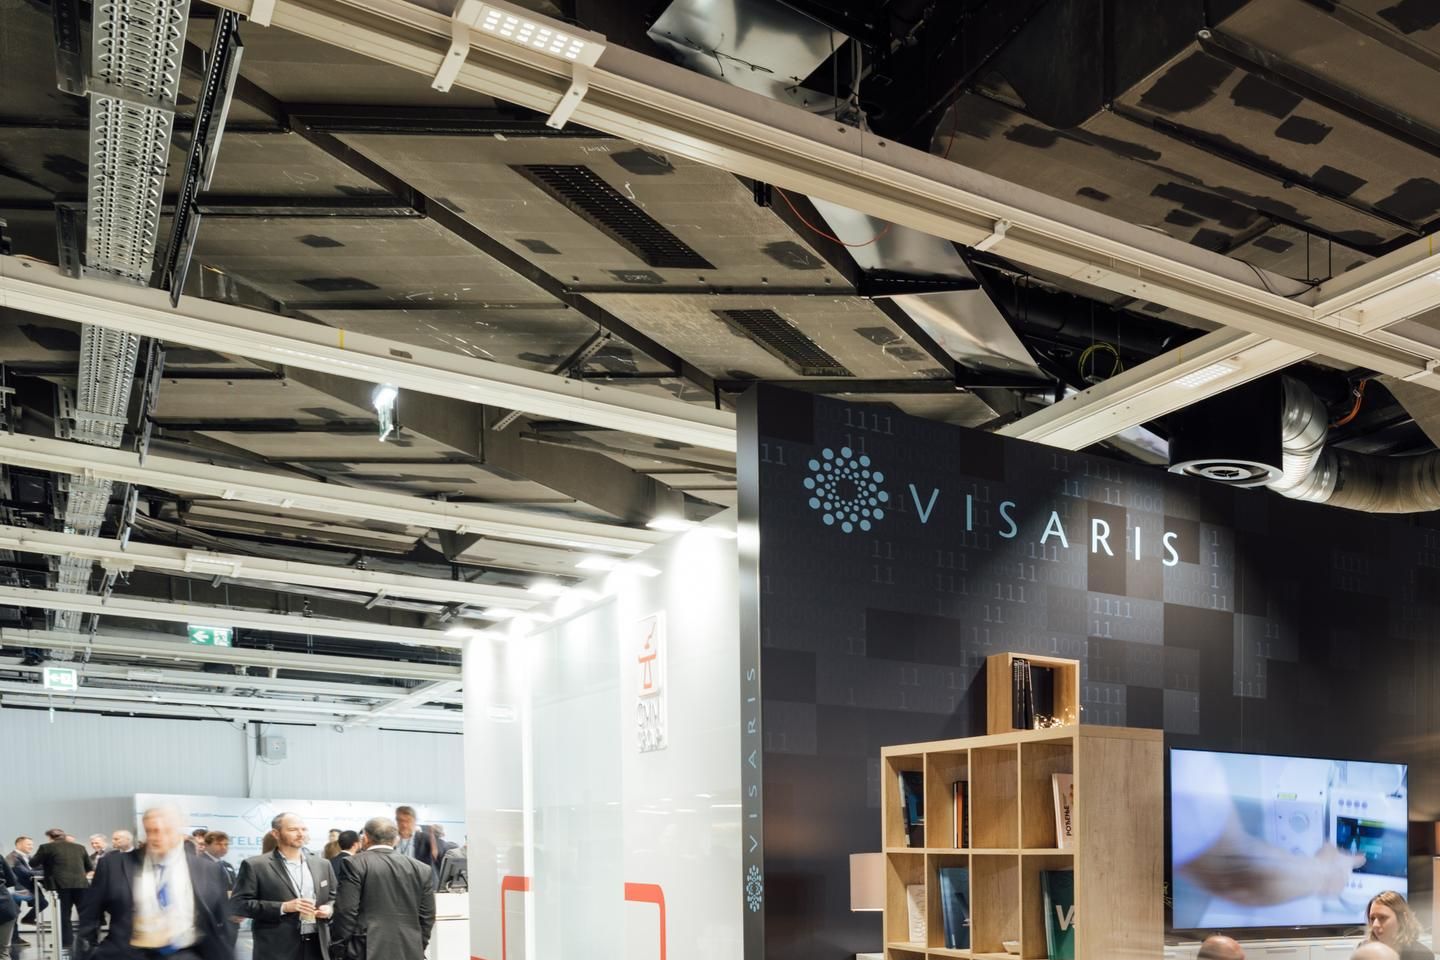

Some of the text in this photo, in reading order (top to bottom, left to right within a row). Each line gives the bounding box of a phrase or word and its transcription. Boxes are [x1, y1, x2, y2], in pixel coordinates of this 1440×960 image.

[908, 482, 1181, 567] VISARIS
[746, 667, 759, 853] VISARIS
[1056, 904, 1075, 931] V
